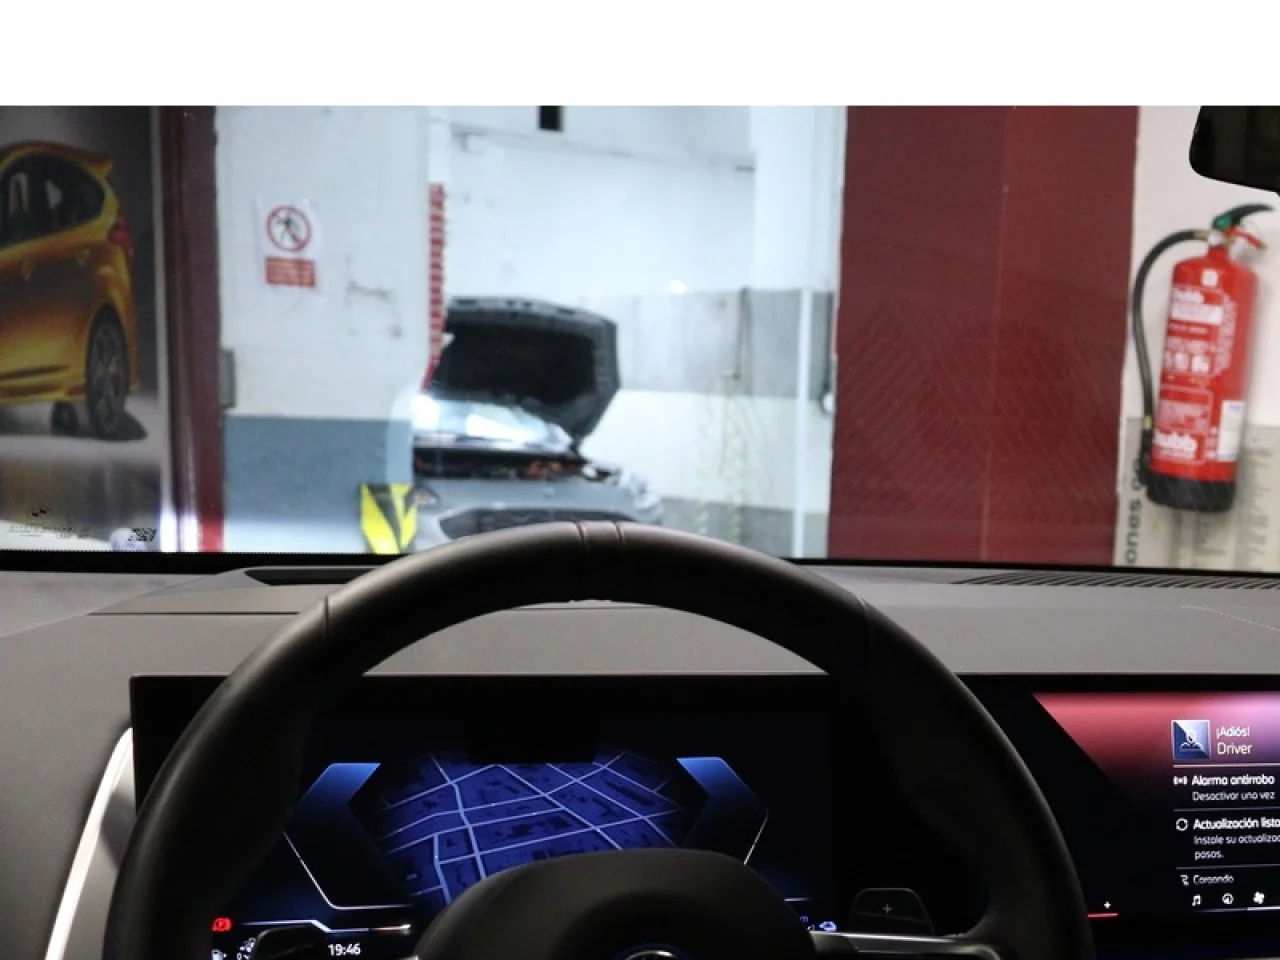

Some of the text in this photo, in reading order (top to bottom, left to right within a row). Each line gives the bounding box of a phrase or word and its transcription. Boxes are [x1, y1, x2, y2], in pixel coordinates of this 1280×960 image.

[1217, 742, 1253, 755] Driver
[1192, 774, 1276, 786] Alarma antirrobo
[1192, 790, 1276, 801] Desactivar una vez
[1193, 817, 1259, 830] Actualización
[1260, 816, 1280, 828] lista
[1193, 834, 1224, 846] Instale
[1225, 835, 1236, 844] su
[1194, 850, 1224, 861] pasos.
[328, 943, 361, 956] 19:46
